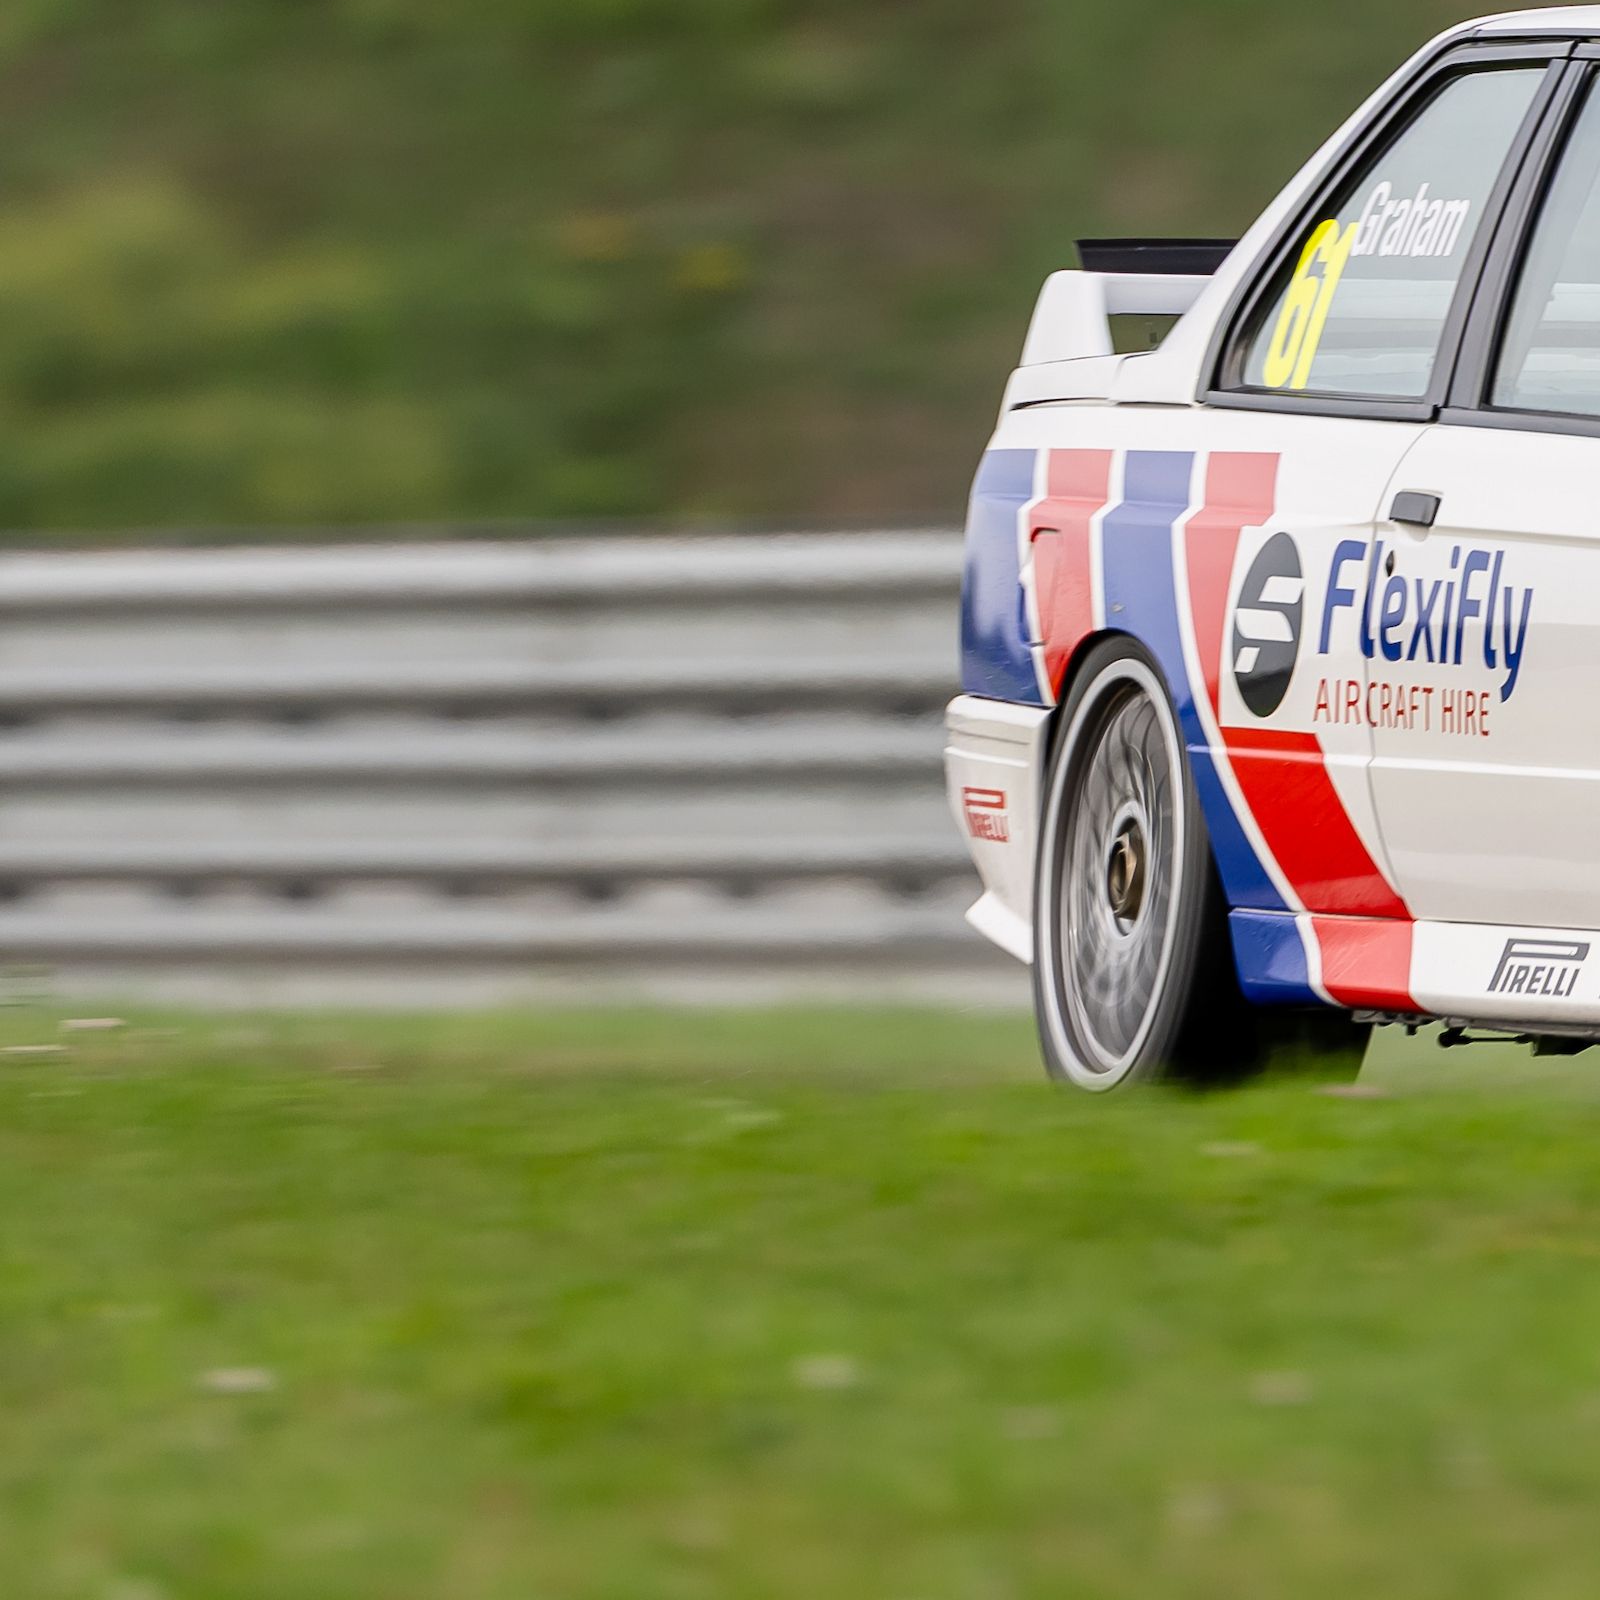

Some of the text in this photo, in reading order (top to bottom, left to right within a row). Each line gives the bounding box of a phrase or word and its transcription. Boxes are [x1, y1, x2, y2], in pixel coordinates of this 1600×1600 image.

[1350, 180, 1471, 258] Graham
[1263, 218, 1361, 390] 61
[1316, 539, 1534, 703] FlexiFly
[1313, 678, 1491, 737] AIRCRAFT HIRE
[1486, 938, 1591, 997] PIRELLI
